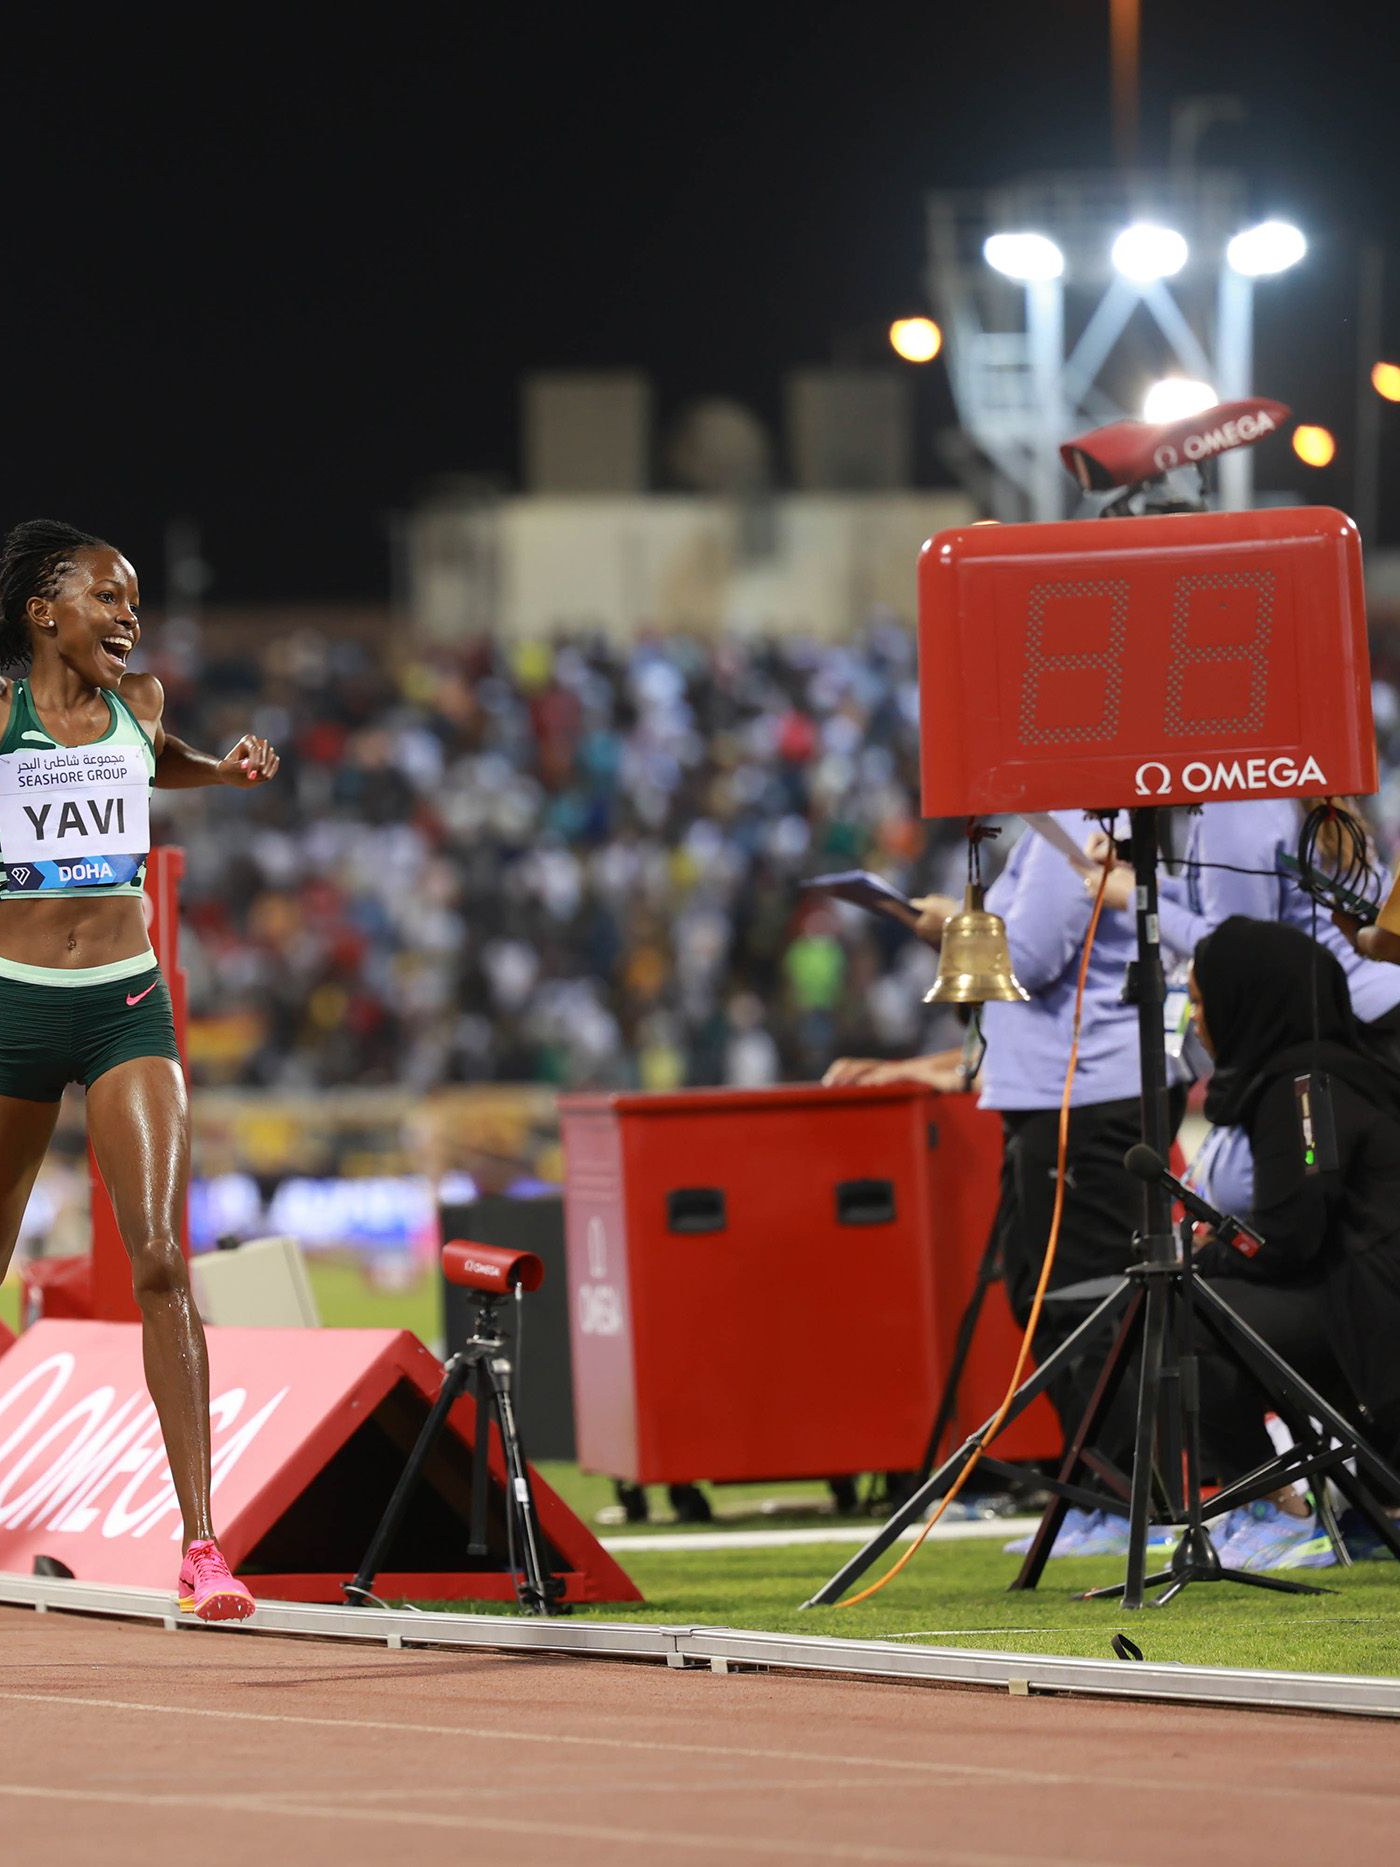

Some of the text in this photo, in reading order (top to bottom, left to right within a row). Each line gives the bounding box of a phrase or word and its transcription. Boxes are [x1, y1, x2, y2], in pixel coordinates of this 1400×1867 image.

[1183, 410, 1276, 460] OMEGA
[17, 757, 41, 774] البحر
[83, 754, 125, 767] مجموعة
[18, 767, 128, 788] SEASHORE GROUP
[1182, 755, 1327, 793] OMEGA
[23, 798, 125, 841] YAVI
[58, 862, 113, 882] DOHA
